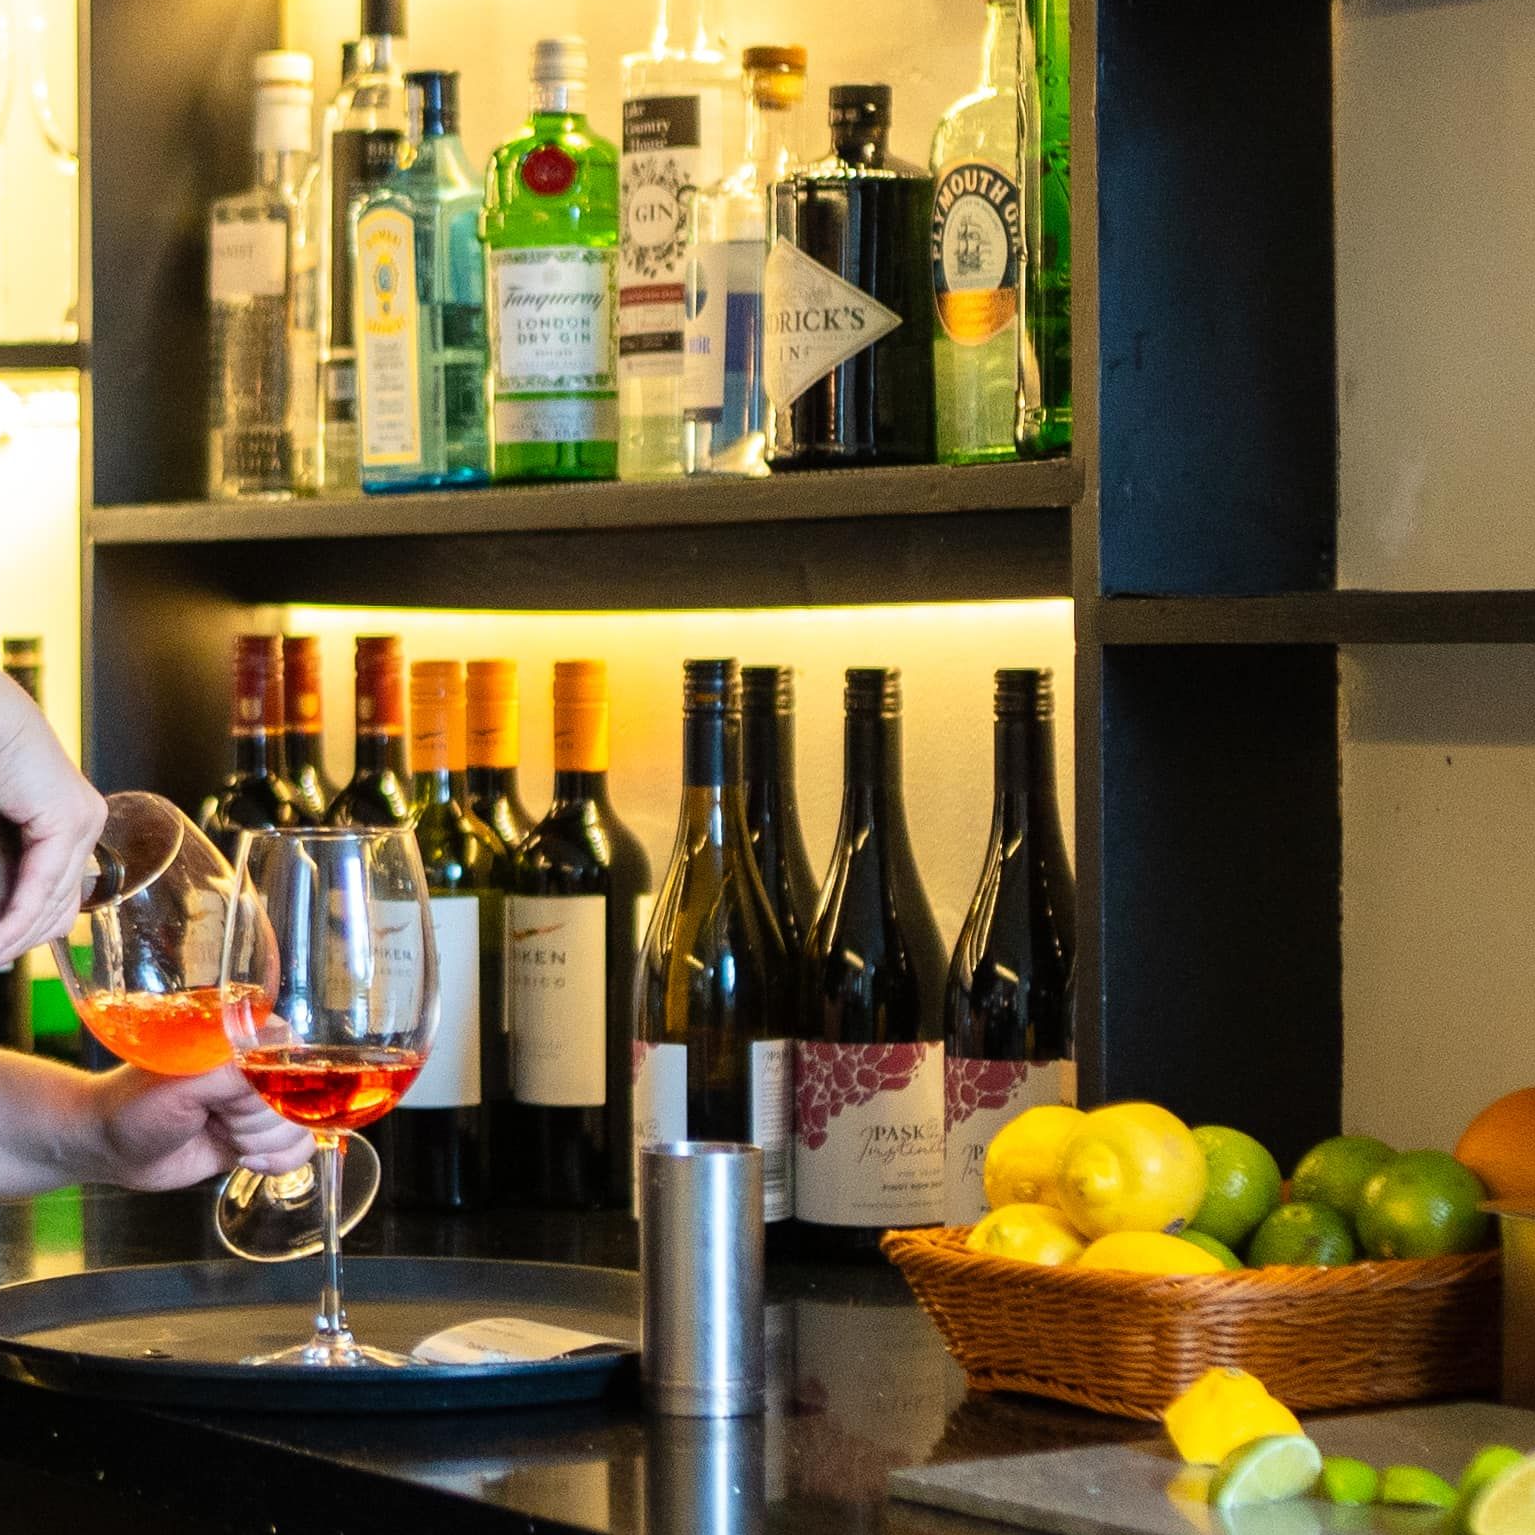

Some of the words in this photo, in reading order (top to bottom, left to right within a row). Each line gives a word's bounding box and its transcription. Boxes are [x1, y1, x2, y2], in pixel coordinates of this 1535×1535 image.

[634, 203, 675, 223] GIN
[932, 169, 1011, 263] PLYMOUTH
[502, 286, 605, 312] Tanqueray
[516, 317, 592, 331] LONDON
[516, 332, 551, 346] DRY
[559, 331, 592, 345] GIN
[874, 1124, 926, 1142] PASK
